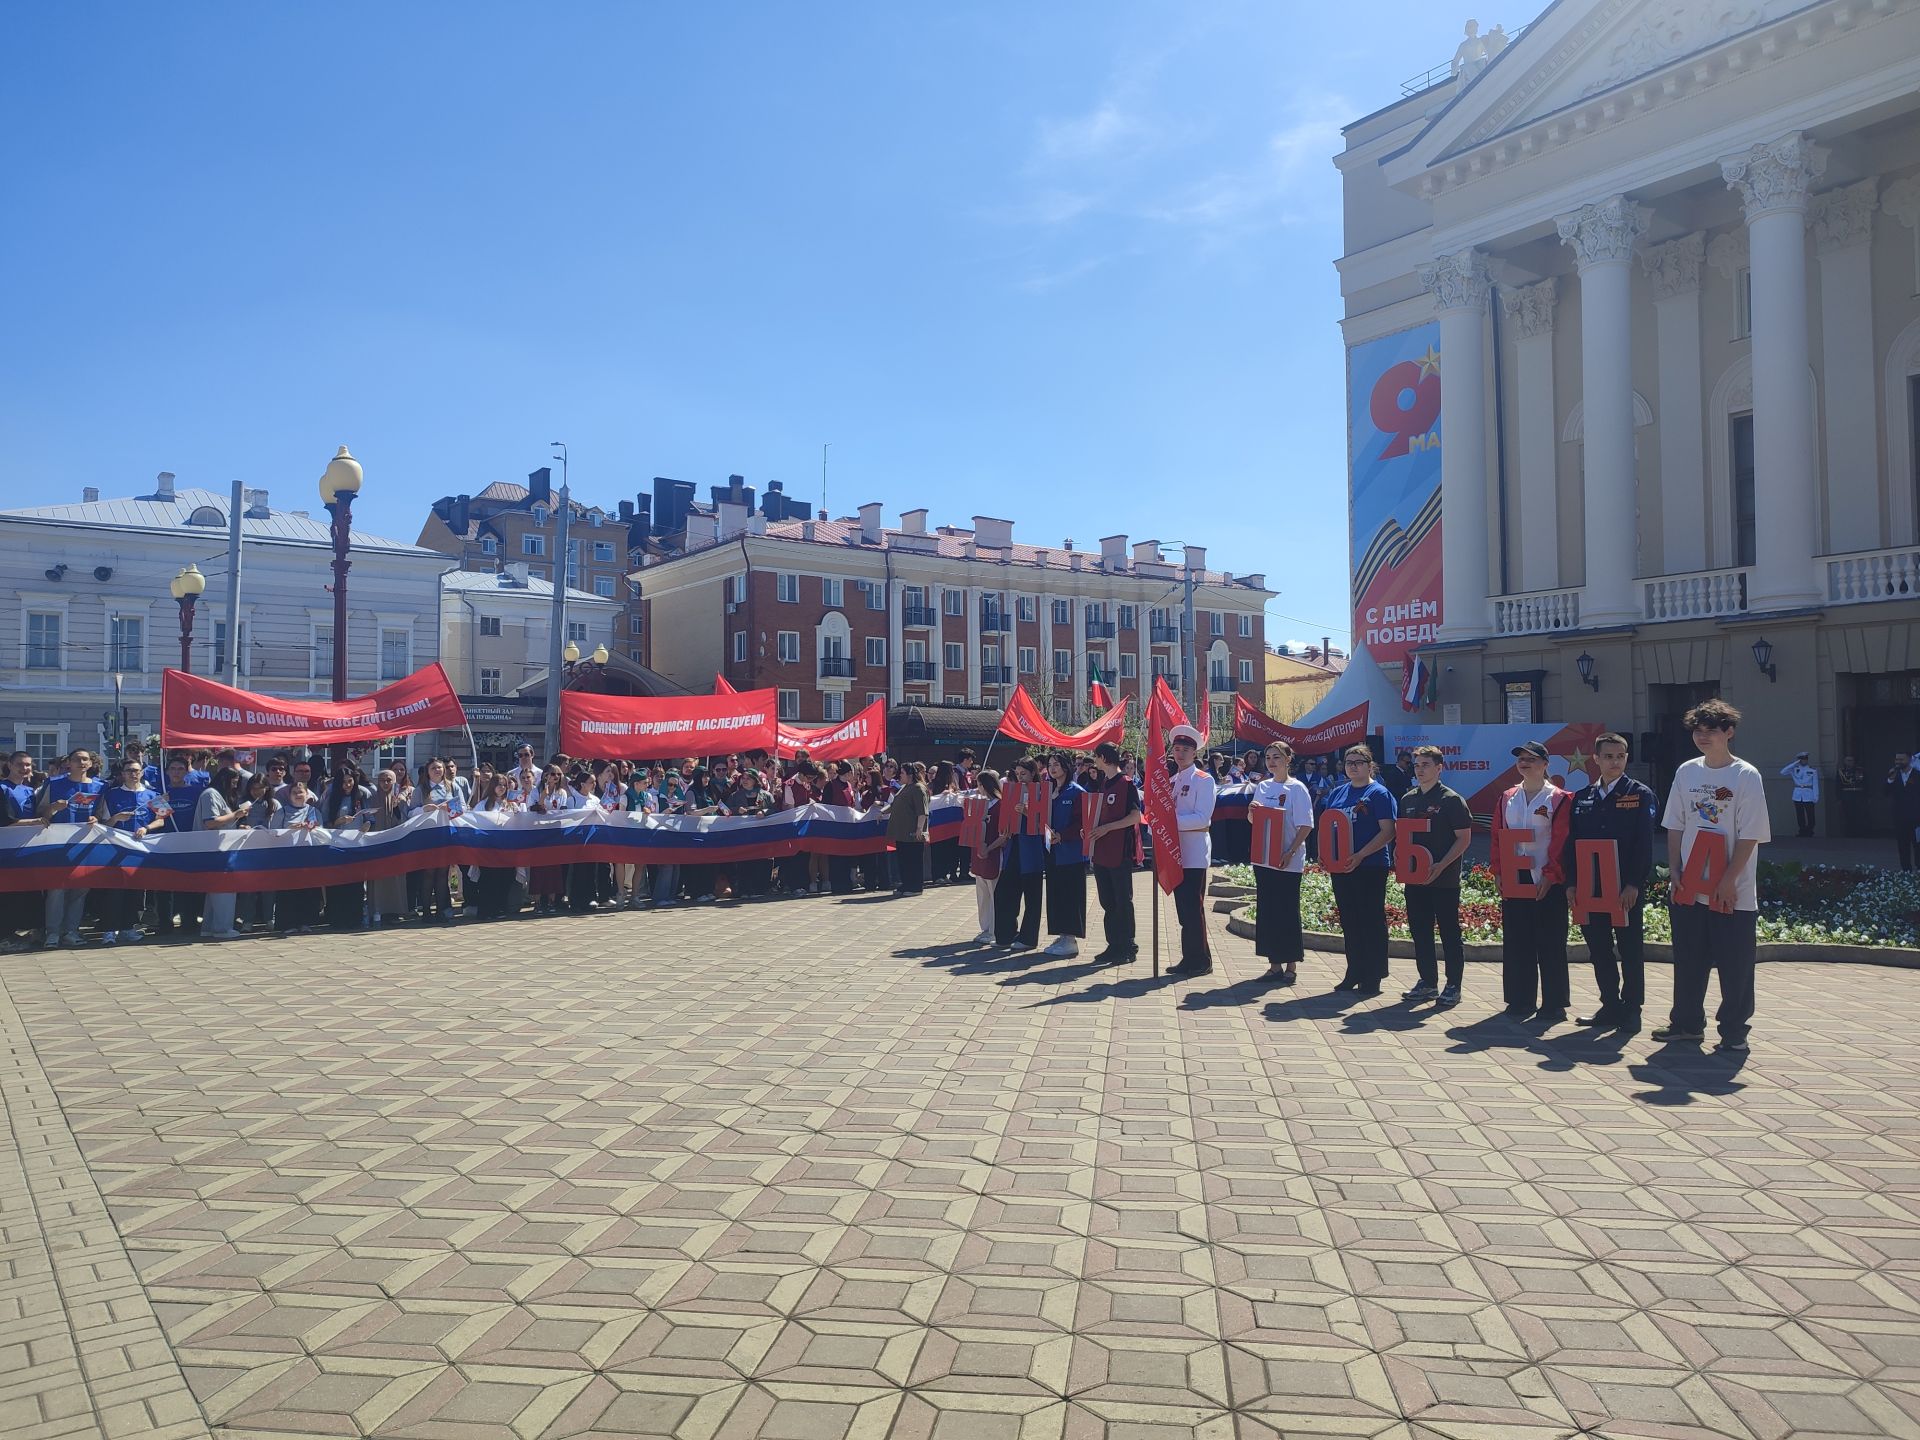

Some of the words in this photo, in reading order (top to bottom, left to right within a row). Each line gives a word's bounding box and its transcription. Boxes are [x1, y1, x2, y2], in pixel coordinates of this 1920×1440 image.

[1370, 360, 1441, 461] 9
[1408, 431, 1441, 454] МА
[1366, 606, 1380, 625] С
[1382, 599, 1437, 625] ДНЁМ
[189, 703, 242, 723] СЛАВА
[245, 711, 310, 728] ВОИНАМ
[322, 697, 431, 728] ПОБЕДИТЕЛЯМ!
[580, 718, 632, 735] ПОМНИМ!
[634, 717, 694, 735] ГОРДИМСЯ!
[695, 713, 765, 731] НАСЛЕДУЕМ!
